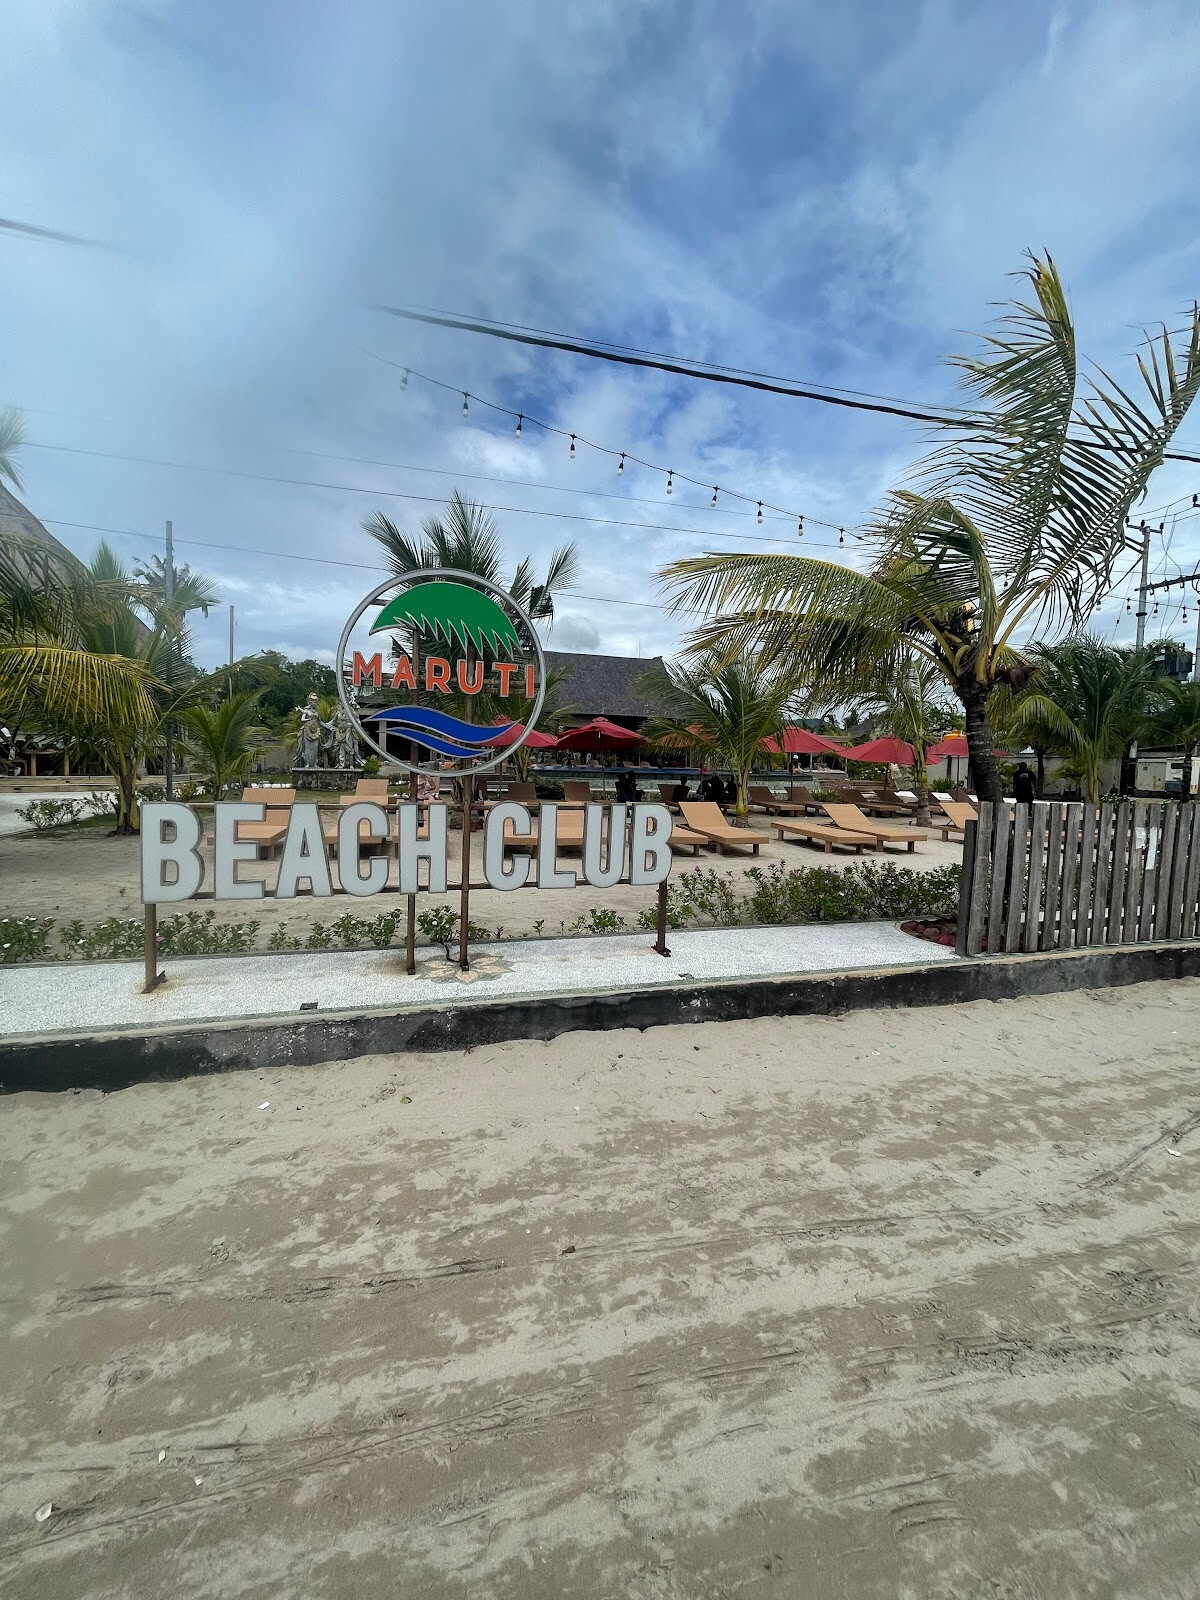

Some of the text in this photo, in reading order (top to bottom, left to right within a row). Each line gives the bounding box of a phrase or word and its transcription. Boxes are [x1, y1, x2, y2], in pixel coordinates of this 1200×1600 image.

[352, 651, 535, 698] MARUTI
[141, 801, 673, 904] BEACH CLUB
